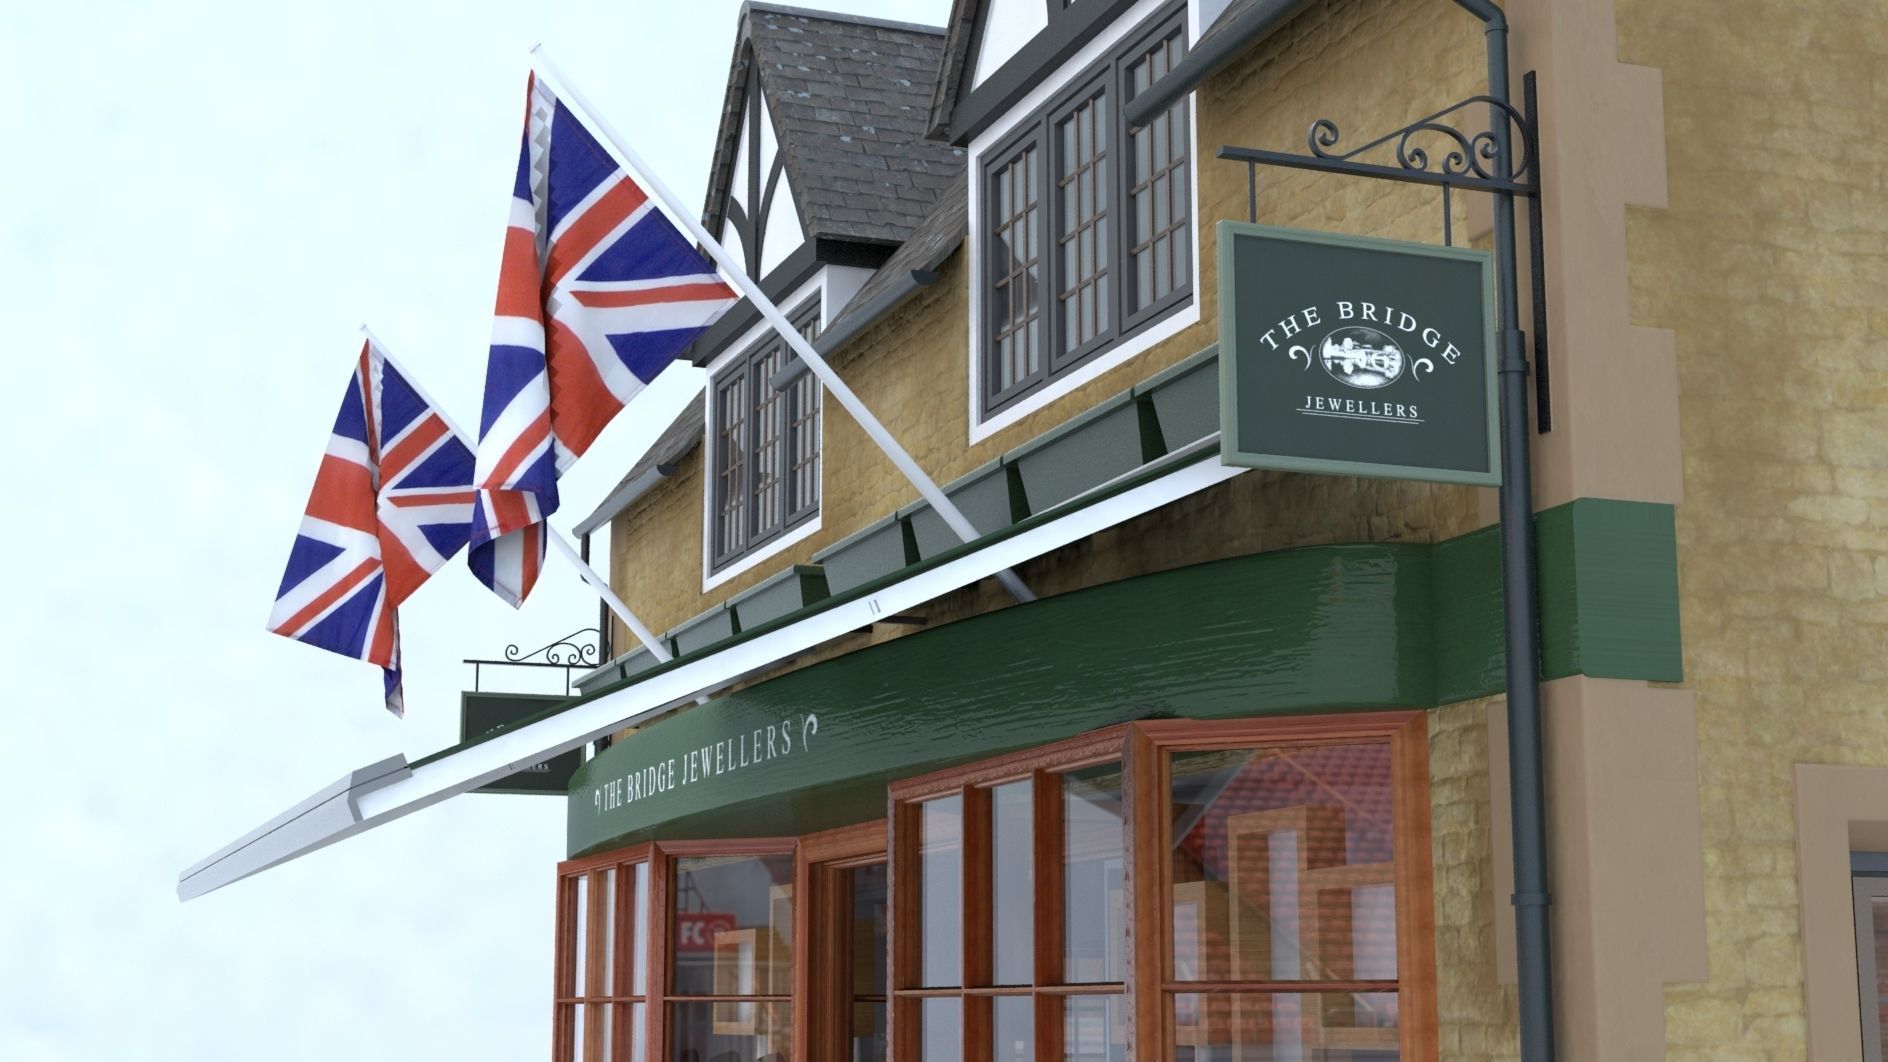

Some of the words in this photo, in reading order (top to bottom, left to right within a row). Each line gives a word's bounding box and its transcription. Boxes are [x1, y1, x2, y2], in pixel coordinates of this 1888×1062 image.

[1259, 305, 1322, 351] THE
[1335, 300, 1462, 365] BRIDGE
[1304, 395, 1418, 419] JEWELLERS
[603, 778, 623, 812] THE
[627, 758, 675, 804] BRIDGE
[682, 719, 792, 786] JEWELLERS
